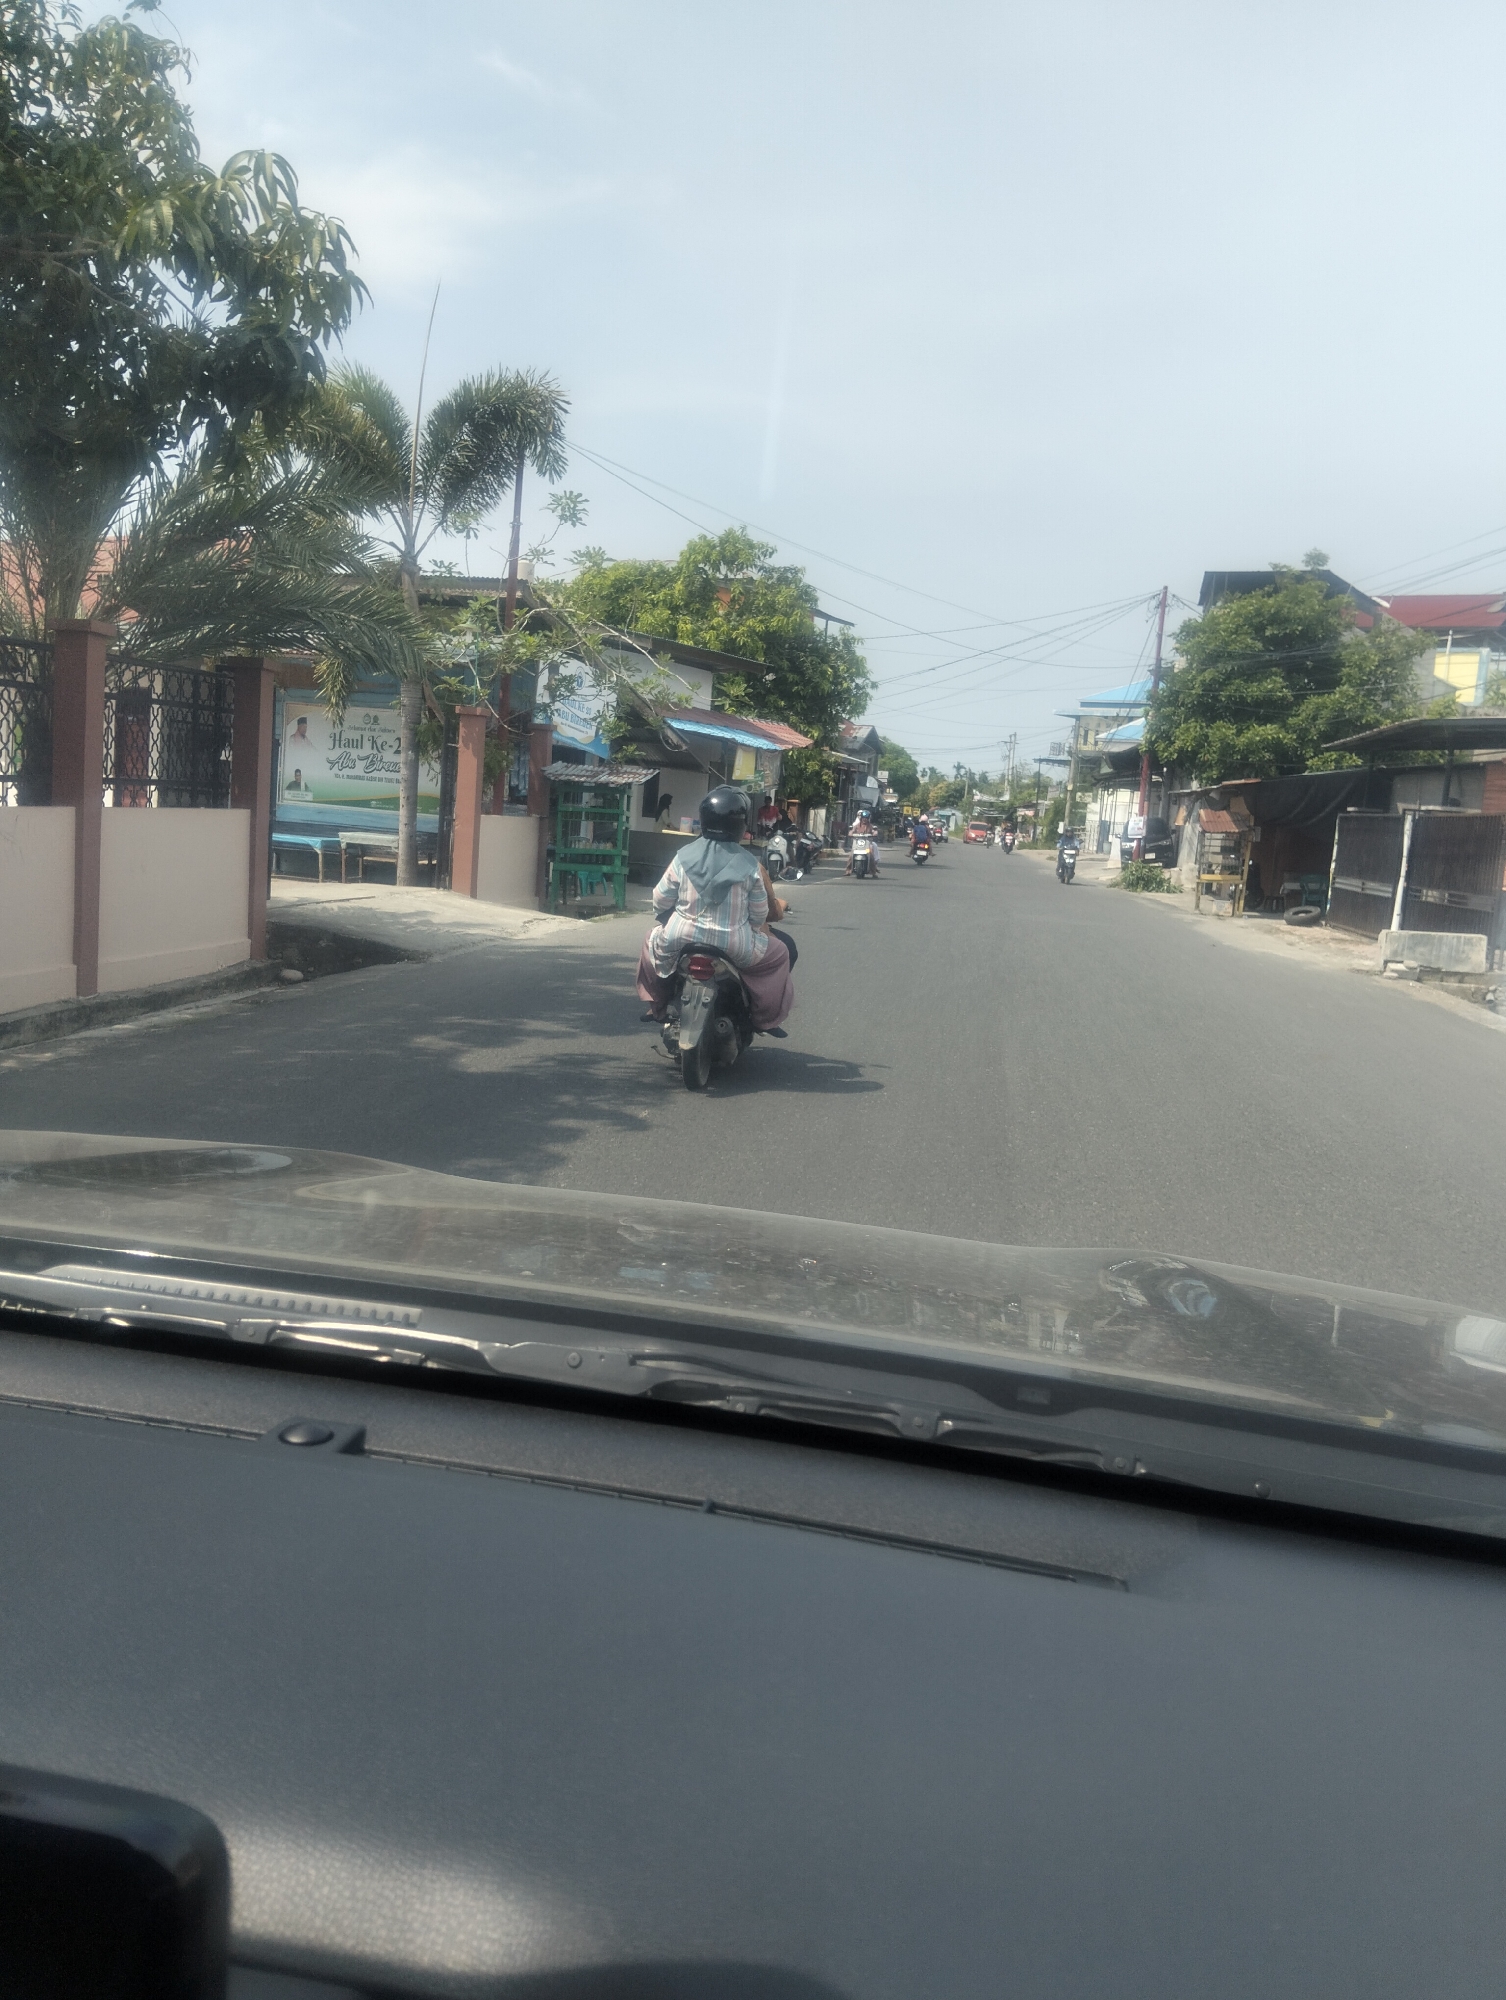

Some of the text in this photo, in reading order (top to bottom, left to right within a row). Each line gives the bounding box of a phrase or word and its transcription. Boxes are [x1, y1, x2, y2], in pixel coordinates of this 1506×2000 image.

[328, 729, 402, 755] Haul Ke-2
[326, 751, 401, 774] Abu Bireue
